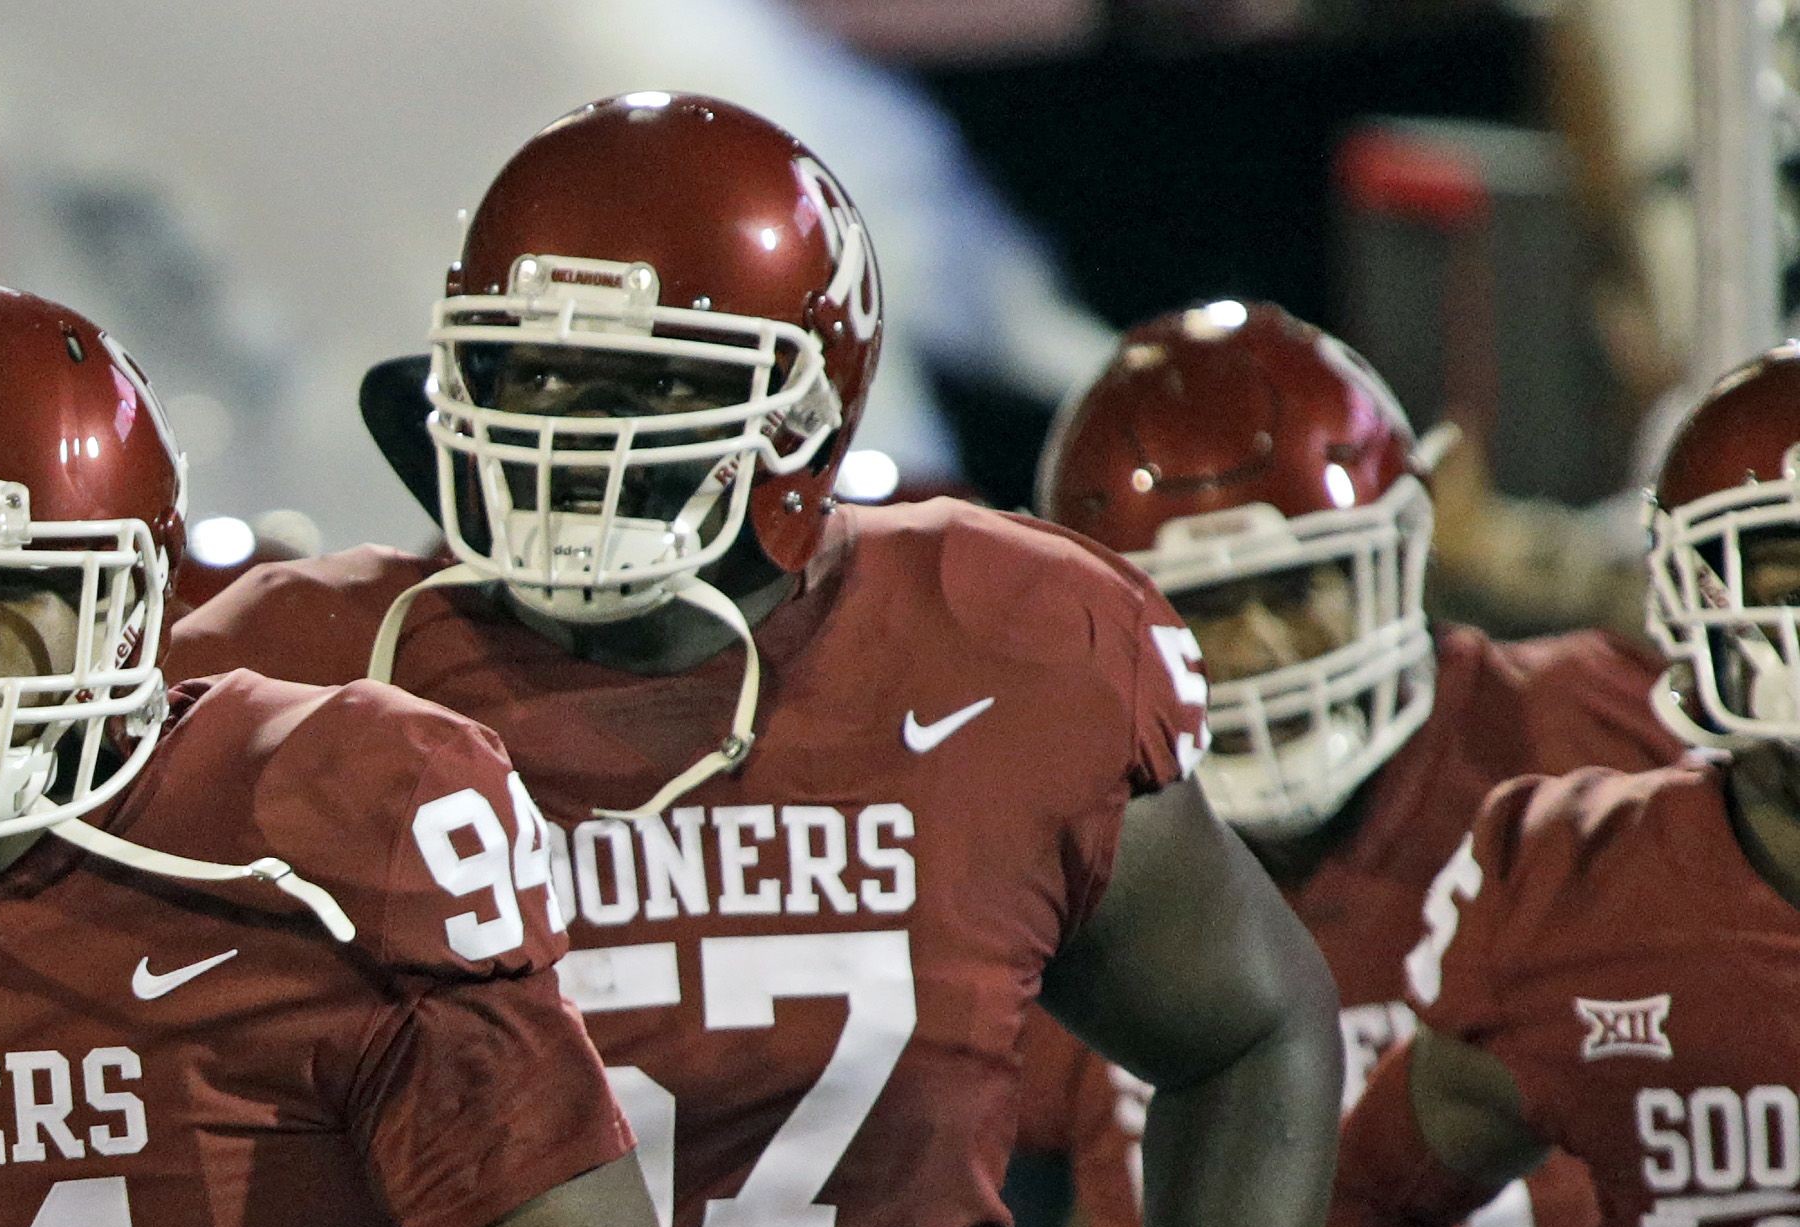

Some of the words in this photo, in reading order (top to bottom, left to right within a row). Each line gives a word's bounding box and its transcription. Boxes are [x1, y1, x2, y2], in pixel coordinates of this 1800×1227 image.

[551, 268, 623, 289] OKLAHOMA
[412, 771, 569, 962] 94
[550, 803, 918, 926] ONERS
